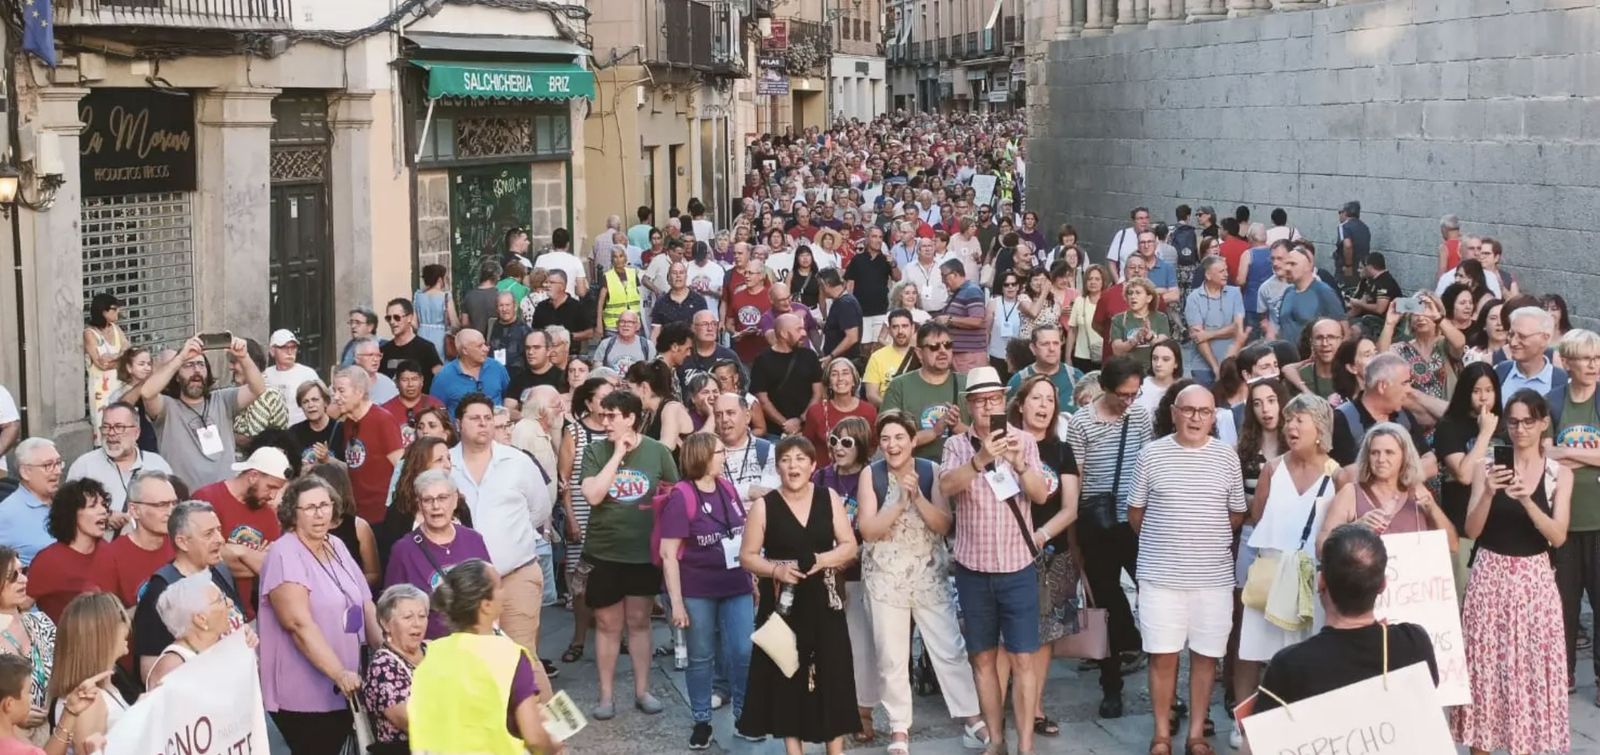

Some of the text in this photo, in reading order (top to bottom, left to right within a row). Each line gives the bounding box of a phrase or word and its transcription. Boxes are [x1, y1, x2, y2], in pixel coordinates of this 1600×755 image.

[463, 72, 570, 92] SALCHICHERIA BRIZ
[109, 105, 190, 159] Morena
[614, 481, 643, 498] XIV
[1395, 576, 1452, 606] GENTE
[1279, 721, 1396, 755] ERECHO
